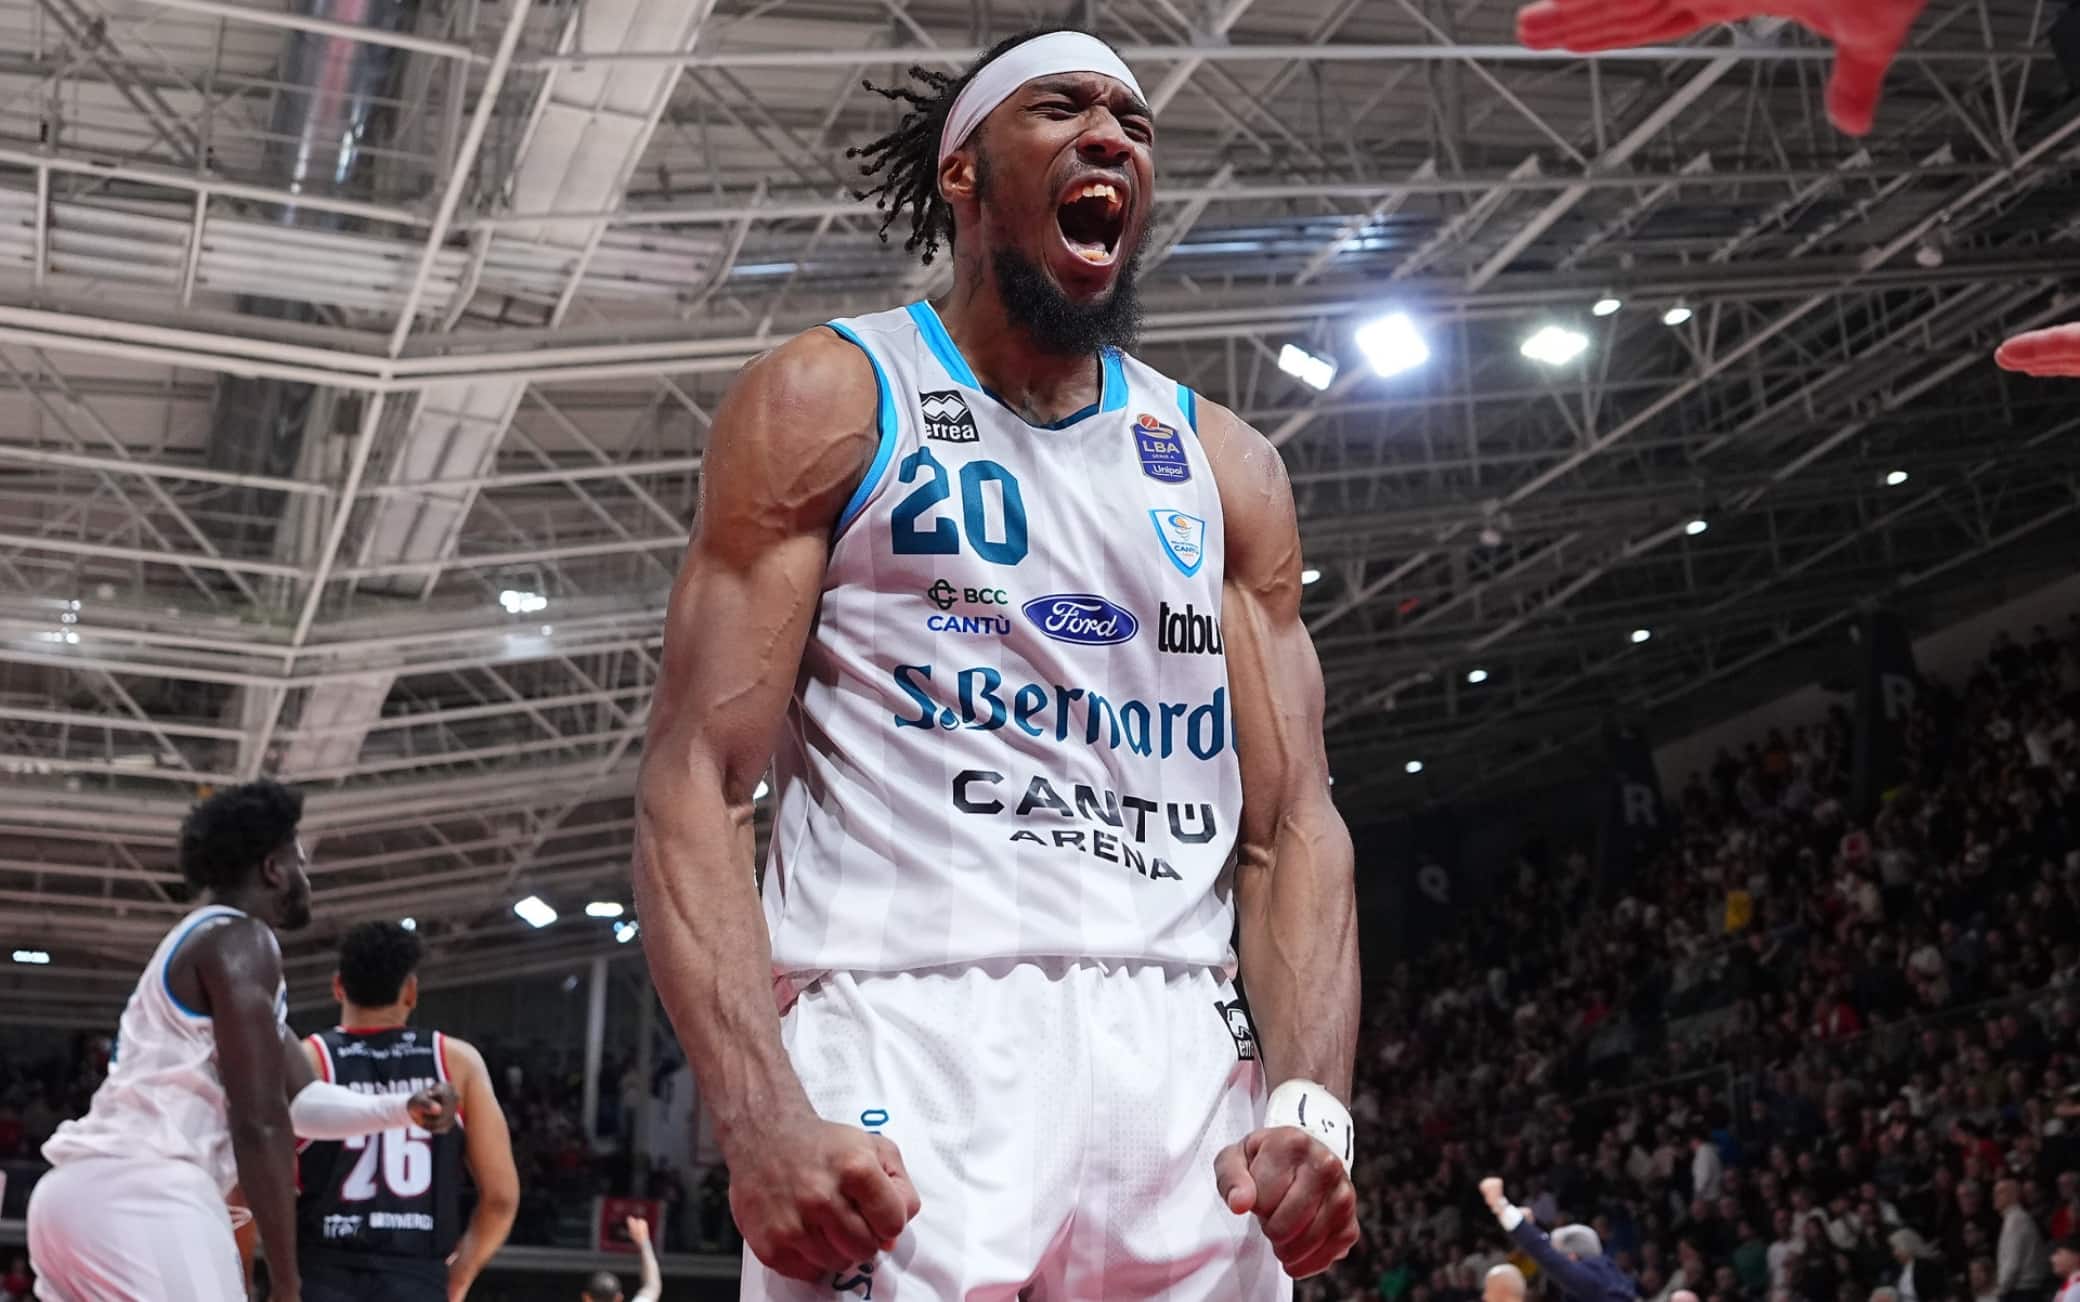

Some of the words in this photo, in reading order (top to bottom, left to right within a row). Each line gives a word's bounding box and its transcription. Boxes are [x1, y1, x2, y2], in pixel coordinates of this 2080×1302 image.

[1143, 440, 1180, 454] LBA
[1153, 464, 1184, 479] Unipol
[891, 446, 1029, 566] 20
[964, 588, 1008, 605] BCC
[927, 614, 1010, 635] CANTÙ
[1046, 601, 1119, 637] Ford
[893, 664, 1239, 761] S.Bernard
[1623, 783, 1657, 828] R
[1010, 830, 1183, 881] ARENA
